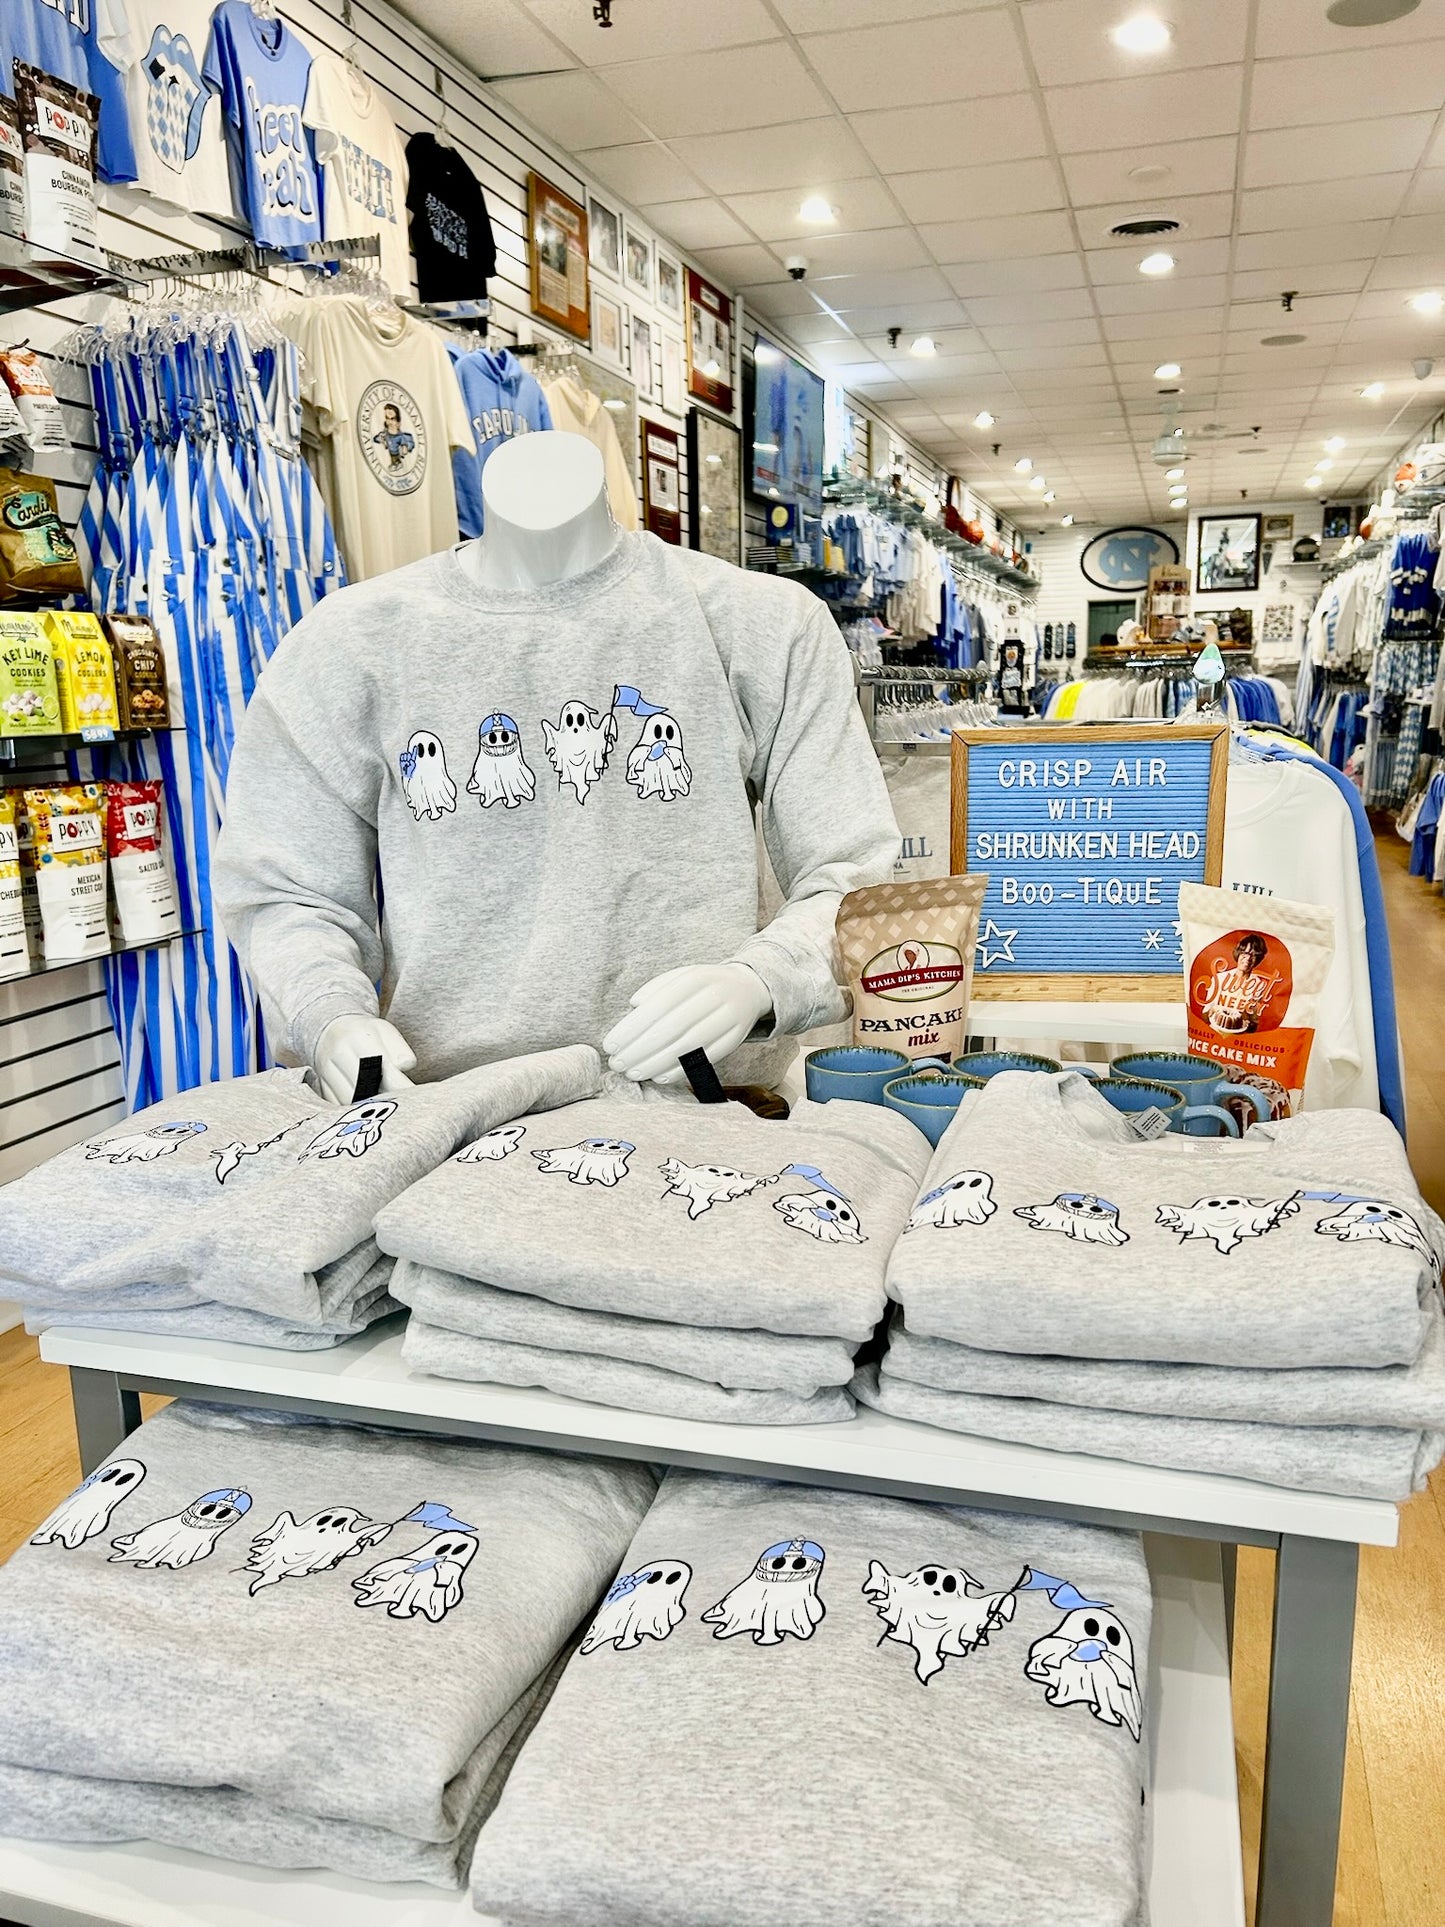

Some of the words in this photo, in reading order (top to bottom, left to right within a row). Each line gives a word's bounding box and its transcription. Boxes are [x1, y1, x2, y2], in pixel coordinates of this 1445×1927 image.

[45, 106, 87, 141] POPPY
[0, 189, 23, 203] BOURB
[51, 179, 84, 197] BOURBON
[2, 649, 22, 666] KEY
[24, 647, 49, 665] LIME
[75, 651, 106, 665] LEMON
[134, 660, 155, 671] CHIP
[10, 668, 46, 677] COOKIES
[998, 759, 1093, 788] CRISP
[1110, 758, 1168, 787] AIR
[1047, 798, 1113, 821] WITH
[58, 819, 97, 840] POPPY
[898, 836, 933, 859] ILL
[975, 831, 1118, 860] SHRUNKEN
[1129, 830, 1201, 860] HEAD
[77, 874, 101, 884] MEXICAN
[71, 885, 93, 896] STREET
[868, 978, 896, 989] MAMA
[898, 973, 920, 984] DIP'S
[923, 969, 961, 980] KITCHEN
[1193, 957, 1283, 1005] Sweet
[908, 1028, 941, 1047] mix
[1234, 1039, 1285, 1053] DELICIOUS
[1188, 1038, 1209, 1053] PICE
[1211, 1044, 1244, 1062] CAKE
[1246, 1053, 1277, 1068] MIX
